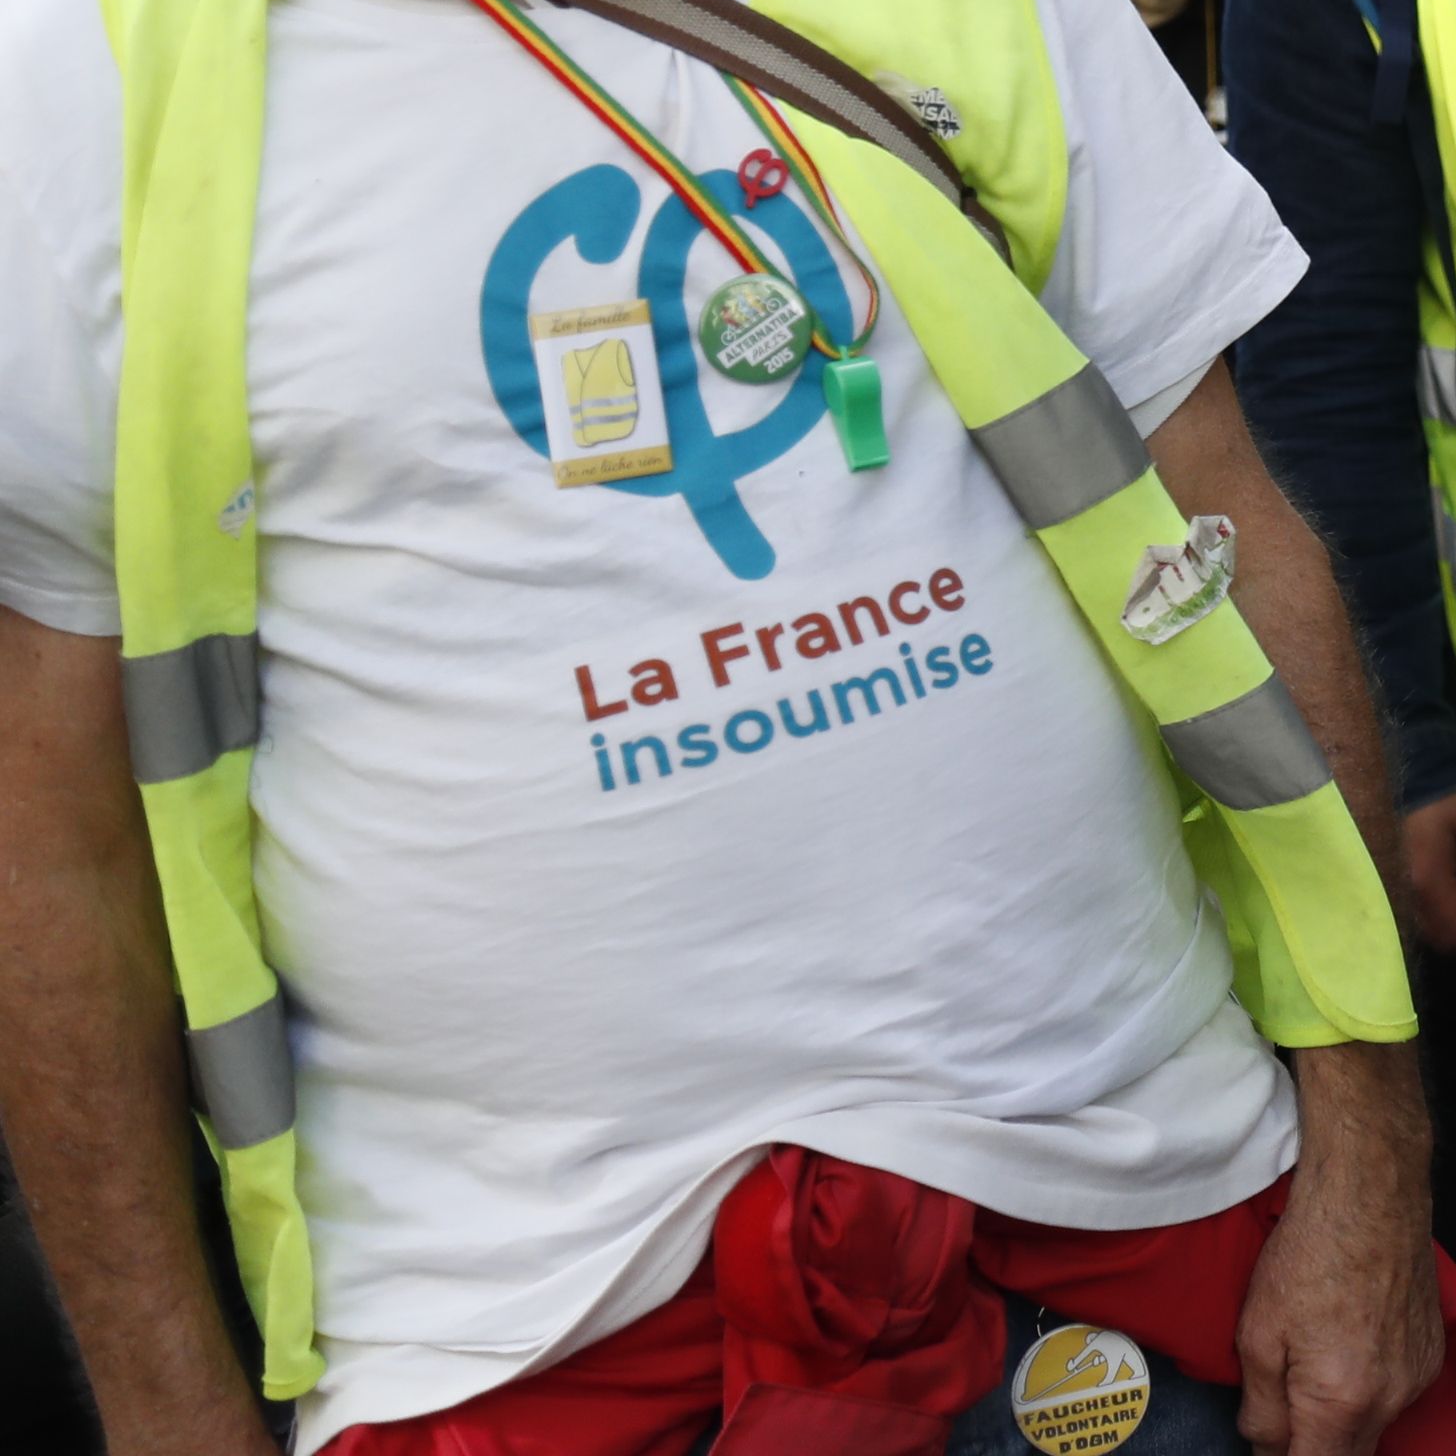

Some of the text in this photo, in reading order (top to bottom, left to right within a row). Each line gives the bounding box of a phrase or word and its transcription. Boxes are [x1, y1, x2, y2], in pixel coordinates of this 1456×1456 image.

[725, 308, 798, 363] ALTERNATIBA
[763, 347, 795, 375] 2015
[574, 567, 967, 722] La France
[589, 631, 994, 793] insoumise
[1023, 1388, 1144, 1426] FAUCHEUR
[1030, 1407, 1139, 1442] VOLONTAIRE
